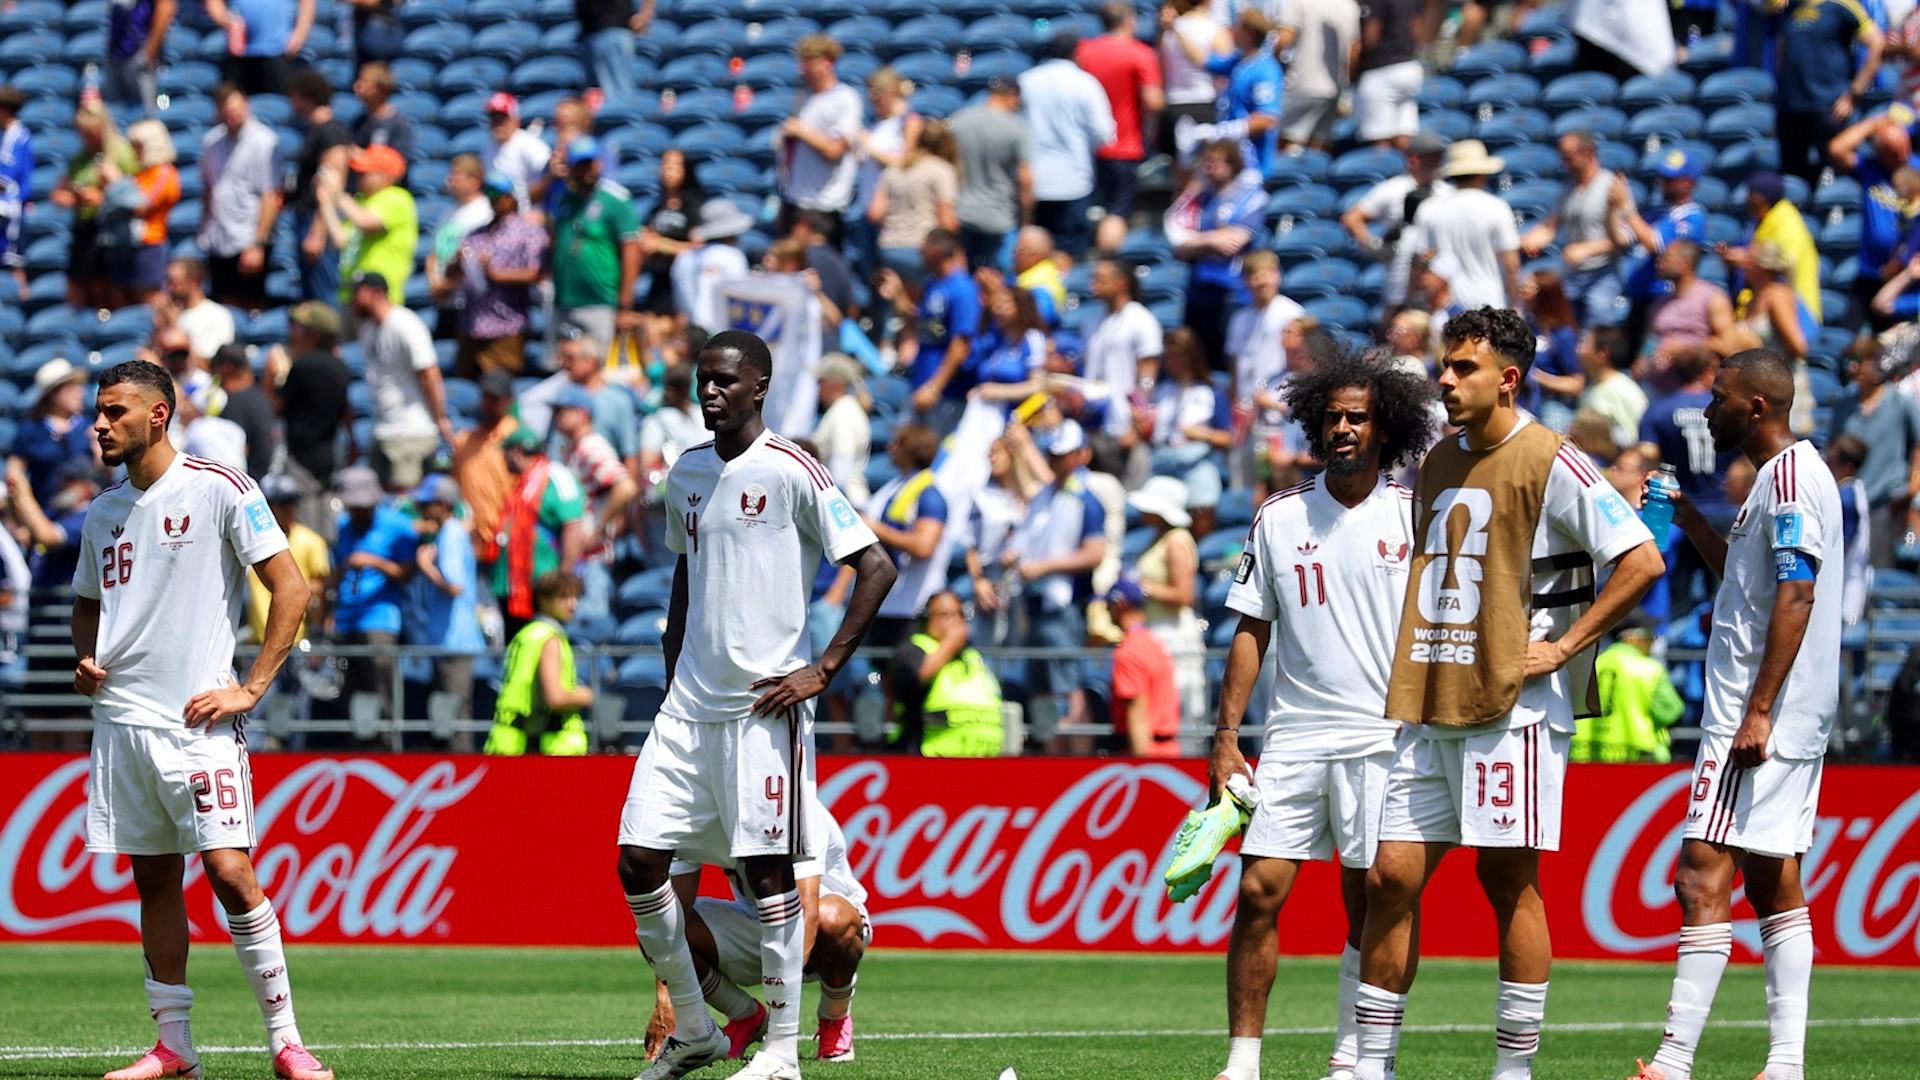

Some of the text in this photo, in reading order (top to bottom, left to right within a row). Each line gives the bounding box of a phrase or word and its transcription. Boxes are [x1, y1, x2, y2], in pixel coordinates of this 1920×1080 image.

[685, 511, 699, 554] 4
[102, 542, 133, 588] 26
[1294, 562, 1325, 607] 11
[1437, 596, 1461, 611] FFA
[1409, 642, 1476, 665] 2026
[1413, 627, 1477, 643] WOD CUP
[190, 768, 238, 813] 26
[765, 775, 784, 817] 4
[1475, 762, 1514, 807] 13
[1693, 760, 1717, 801] 6
[0, 757, 488, 938] CoCola
[262, 965, 285, 979] QFA
[763, 975, 785, 987] QFA
